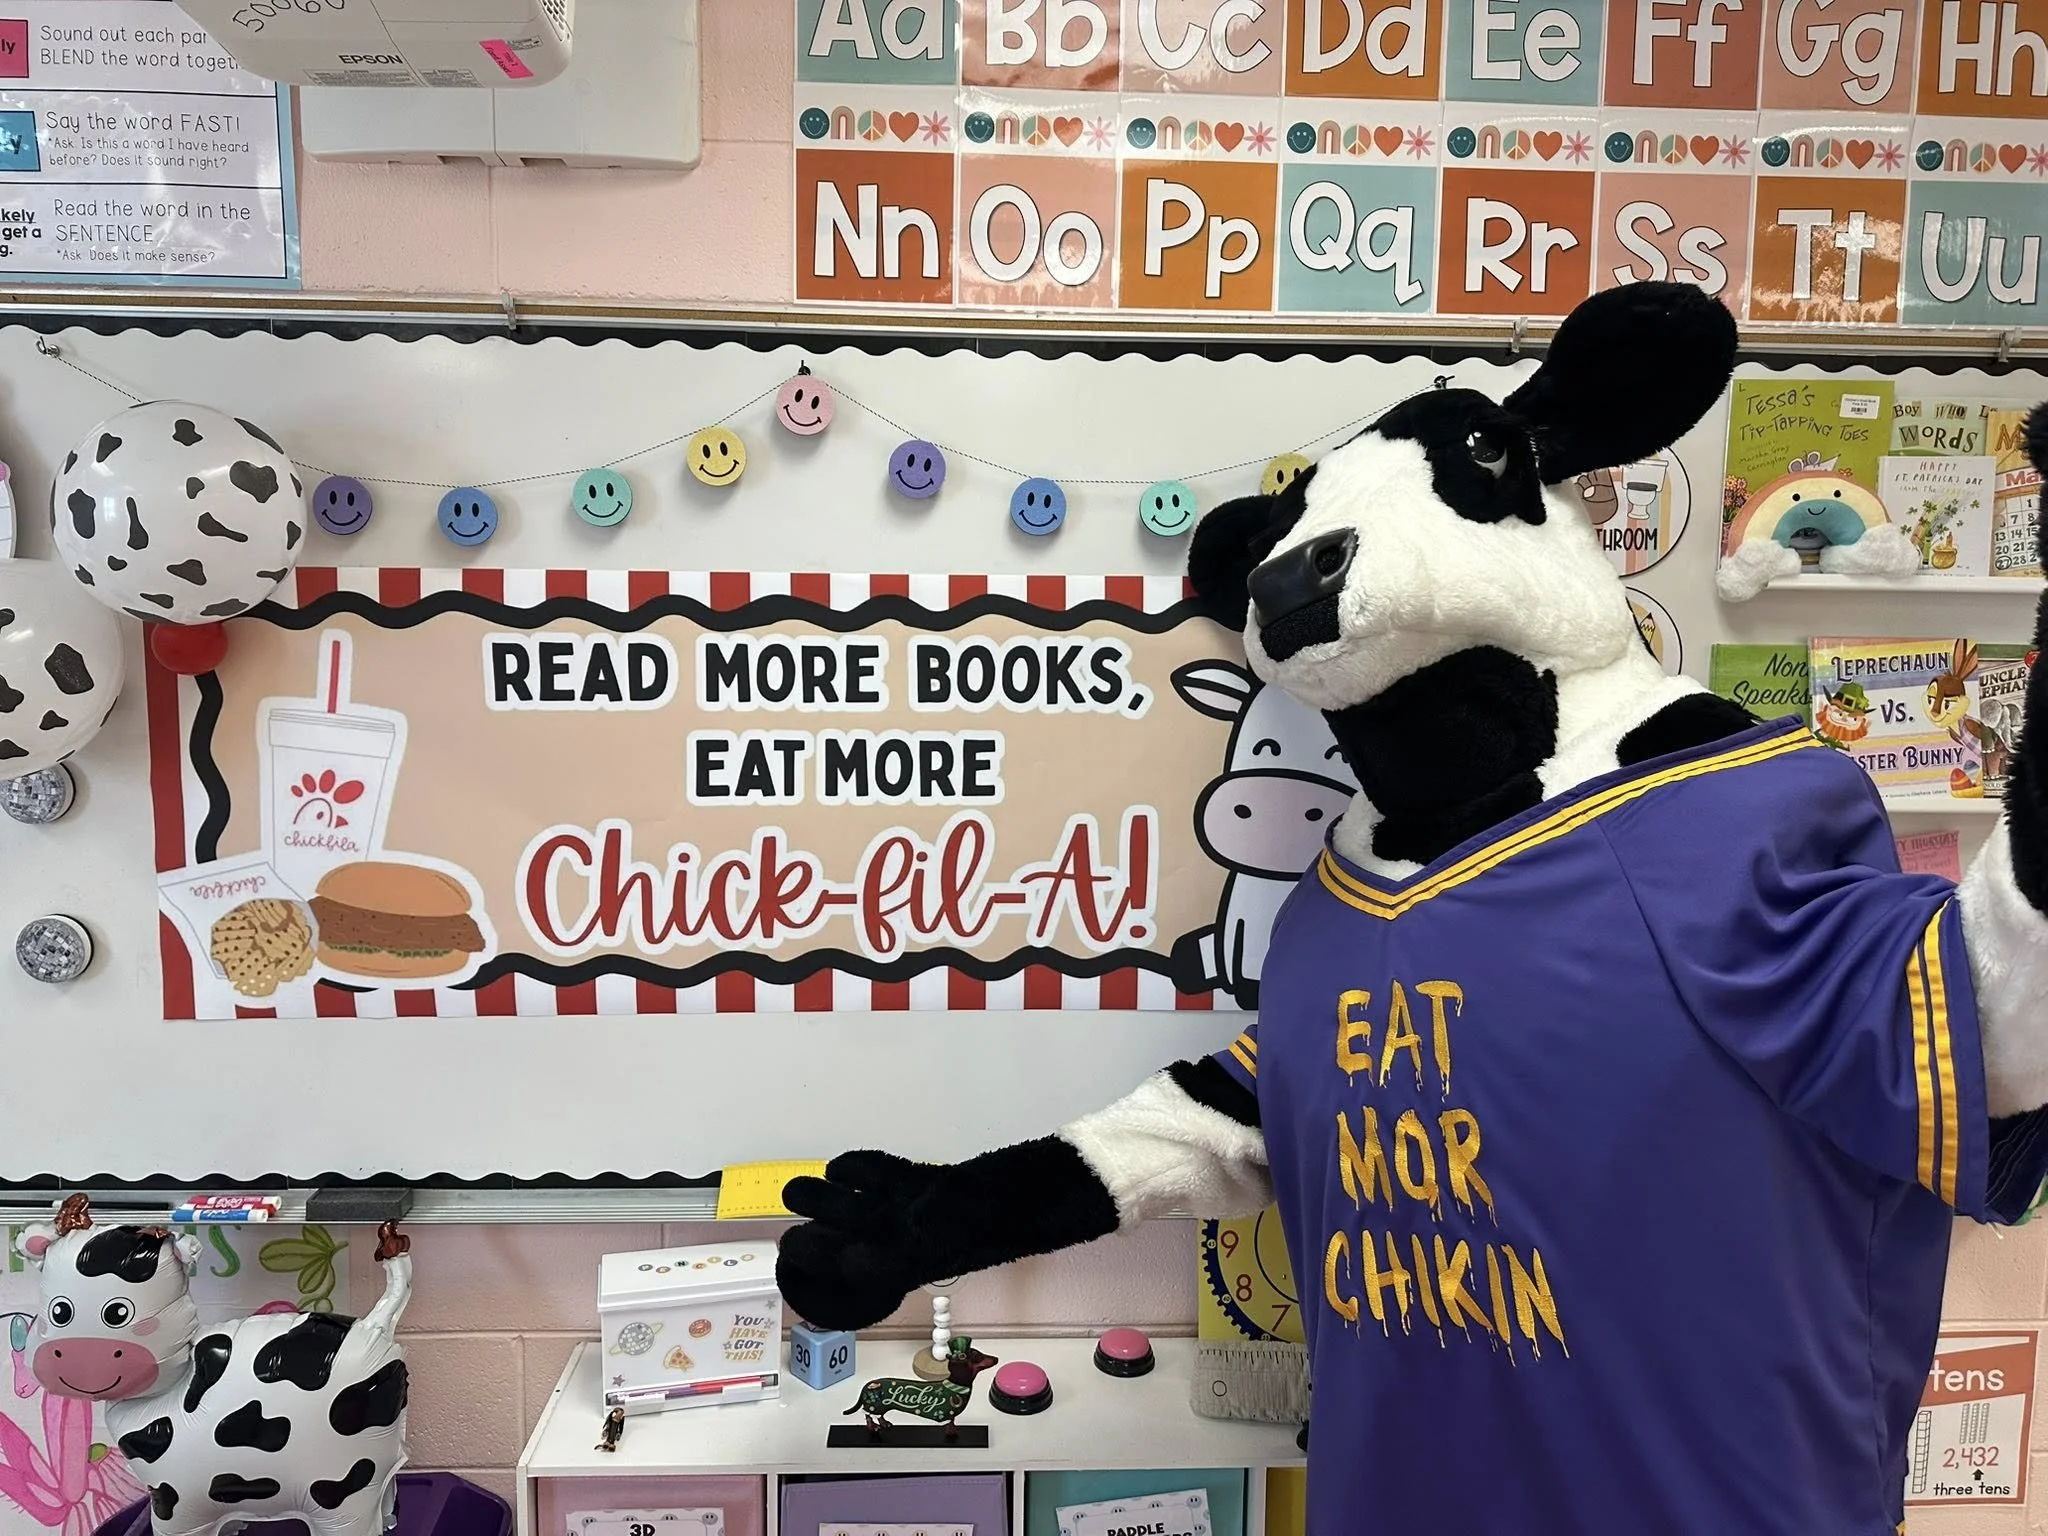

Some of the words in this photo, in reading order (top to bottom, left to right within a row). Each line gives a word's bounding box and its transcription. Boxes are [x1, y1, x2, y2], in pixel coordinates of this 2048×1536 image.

[40, 25, 93, 42] Sound
[100, 28, 127, 41] out
[134, 28, 174, 44] each
[808, 0, 944, 60] Aa
[985, 0, 1109, 69] Bb
[1138, 0, 1273, 73] Cc
[1301, 0, 1425, 78] Dd
[1470, 0, 1582, 82] Ee
[40, 48, 95, 65] BLEND
[101, 51, 128, 67] the
[135, 52, 180, 68] word
[1632, 0, 1744, 89] Ff
[1775, 0, 1903, 105] Gg
[1937, 0, 2048, 98] Hh
[339, 54, 403, 65] EPSON
[46, 111, 80, 134] Say
[87, 113, 117, 130] the
[124, 115, 173, 132] word
[81, 136, 93, 149] Is
[97, 137, 118, 149] this
[122, 139, 129, 149] a
[135, 137, 164, 150] word
[168, 138, 175, 150] I
[179, 138, 209, 151] have
[212, 140, 250, 153] heard
[49, 153, 97, 166] before?
[101, 153, 131, 166] Does
[134, 154, 143, 166] it
[147, 154, 184, 167] sound
[189, 156, 227, 170] right?
[54, 198, 97, 216] Read
[104, 200, 133, 217] the
[140, 201, 188, 218] word
[197, 202, 213, 219] in
[221, 203, 250, 220] the
[2, 226, 28, 240] get
[31, 229, 42, 239] a
[55, 224, 153, 242] SENTENCE
[813, 181, 940, 280] Nn
[968, 183, 1103, 287] Oo
[1143, 178, 1261, 298] Pp
[1289, 181, 1425, 305] Qq
[89, 249, 118, 261] Does
[122, 249, 130, 261] it
[134, 250, 166, 262] make
[170, 252, 216, 264] sense?
[1464, 197, 1580, 294] Rr
[1612, 200, 1728, 297] Ss
[1777, 208, 1877, 301] Tt
[1920, 211, 2042, 305] Uu
[1919, 461, 1957, 472] HAPPY
[1965, 477, 1983, 486] DAY
[2011, 514, 2018, 524] 7
[2027, 513, 2034, 522] 8
[1995, 532, 2006, 541] 13
[2011, 529, 2022, 539] 14
[1996, 545, 2009, 555] 20
[2013, 542, 2025, 552] 21
[2012, 556, 2026, 565] 28
[492, 642, 669, 703] READ
[705, 643, 881, 703] MORE
[917, 644, 1146, 711] BOOKS,
[1831, 652, 1949, 682] LEPRECHAUN
[1979, 666, 2027, 687] UNCLE
[696, 738, 805, 797] EAT
[824, 739, 997, 797] MORE
[1903, 746, 1963, 768] BUNNY
[525, 813, 1151, 954] Chick-fil-A!
[1336, 979, 1464, 1100] EAT
[1336, 1105, 1498, 1224] MOR
[1220, 1230, 1239, 1258] 9
[1236, 1274, 1252, 1302] 8
[1324, 1229, 1571, 1364] CHIKIN
[733, 1314, 764, 1327] YOU
[1271, 1304, 1292, 1332] 7
[728, 1327, 768, 1339] HAVE
[734, 1339, 763, 1350] GOT
[724, 1350, 763, 1361] THIS!
[795, 1343, 811, 1369] 30
[828, 1345, 848, 1369] 60
[1929, 1359, 2005, 1392] tens
[881, 1384, 946, 1412] Lucky
[1942, 1446, 1999, 1469] 2,432
[1933, 1483, 1973, 1496] three
[1979, 1482, 2011, 1495] tens
